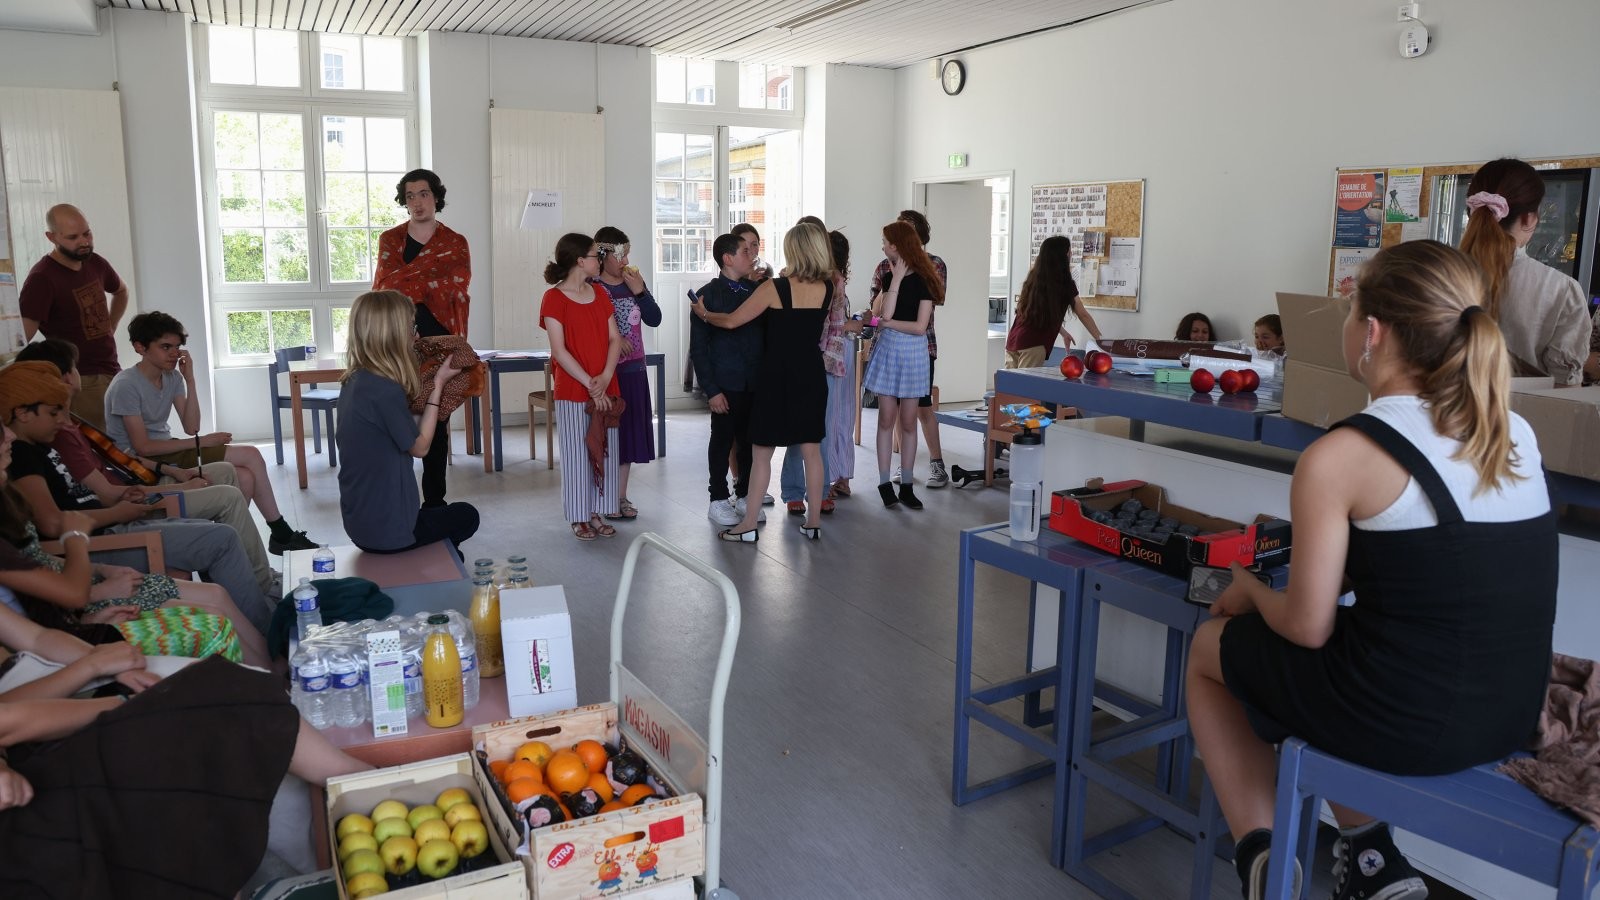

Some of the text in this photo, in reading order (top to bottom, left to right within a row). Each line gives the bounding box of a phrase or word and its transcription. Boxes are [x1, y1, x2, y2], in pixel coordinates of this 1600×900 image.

[1340, 191, 1373, 199] L'ORIENTATION
[1097, 527, 1163, 565] Red Queen
[1255, 538, 1280, 552] Queen
[625, 695, 671, 762] MAGASIN
[549, 844, 574, 869] EXTRA
[594, 848, 621, 865] Elle
[626, 845, 636, 858] et
